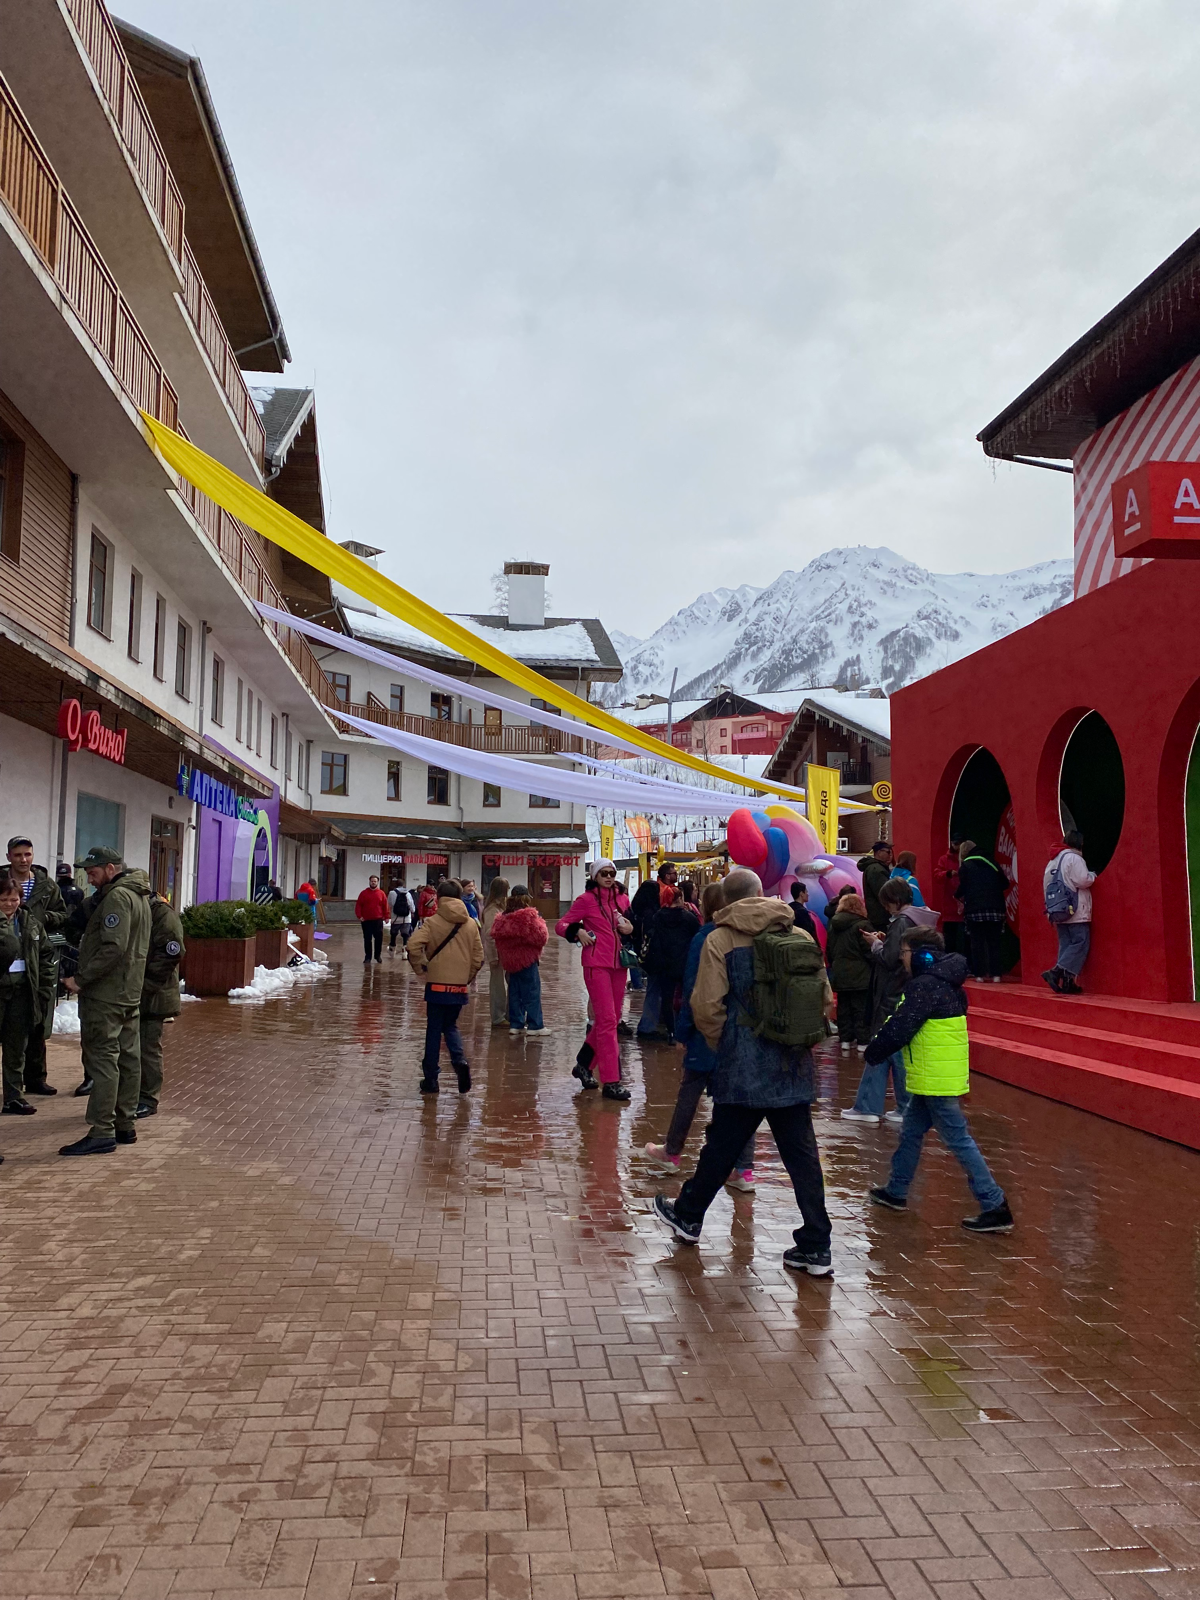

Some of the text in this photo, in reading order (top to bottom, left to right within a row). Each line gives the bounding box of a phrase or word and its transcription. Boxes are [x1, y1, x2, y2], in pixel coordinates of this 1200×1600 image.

[66, 698, 127, 764] О, Вино!
[192, 769, 236, 819] АПТЕКА
[820, 790, 828, 816] Еда
[362, 853, 402, 863] ПИЦЦЕРИЯ
[484, 855, 524, 867] СУШИ
[536, 855, 580, 867] КРАФТ
